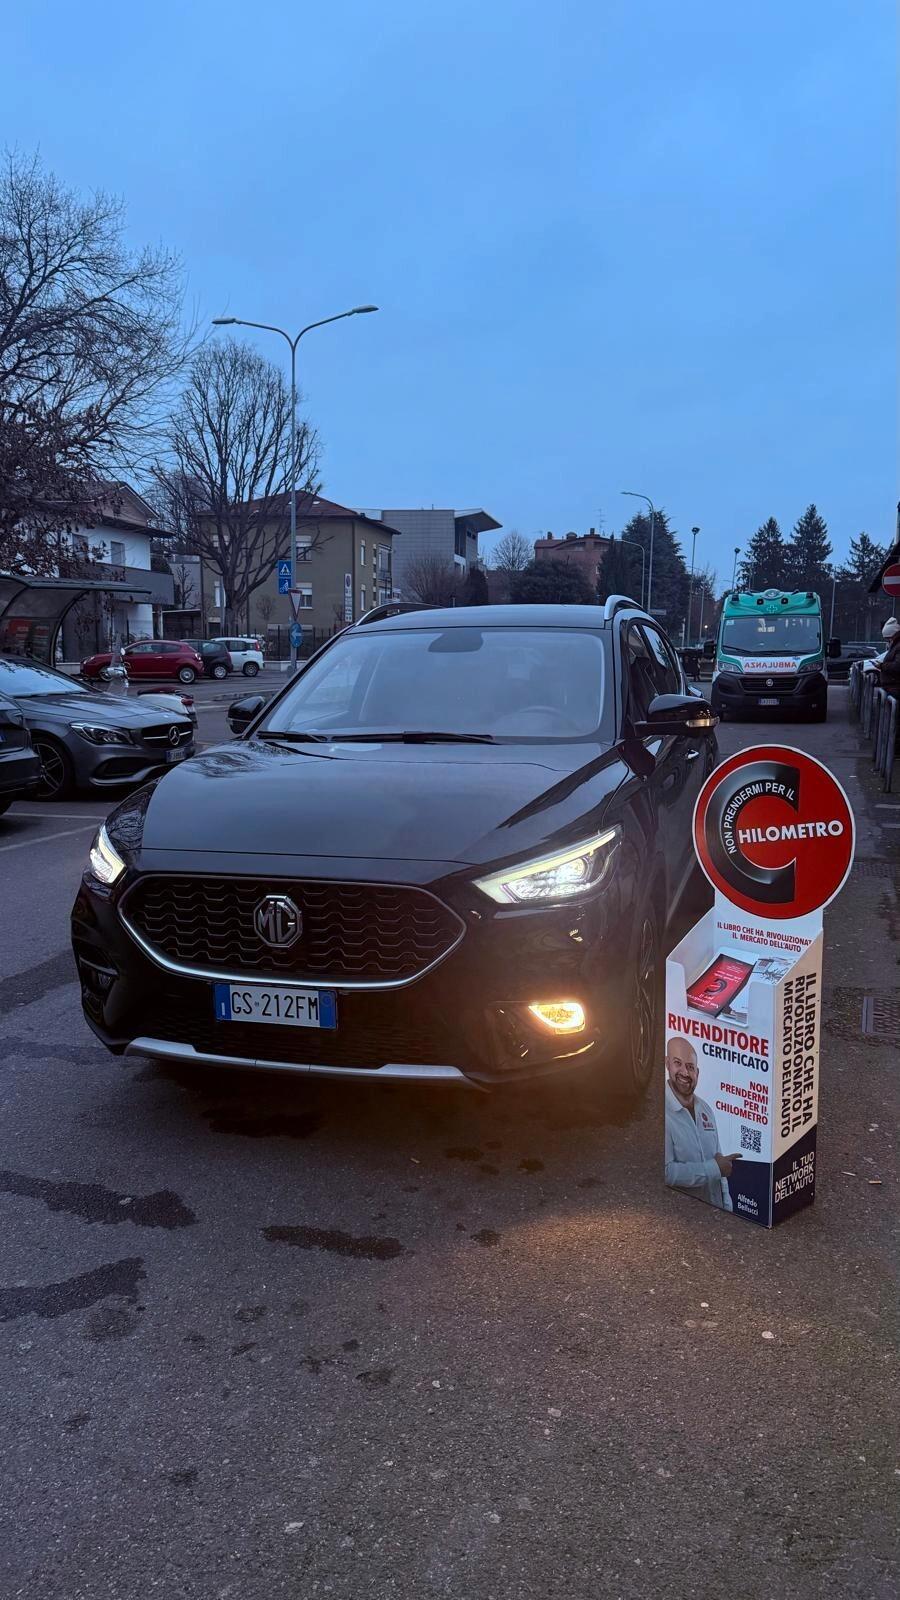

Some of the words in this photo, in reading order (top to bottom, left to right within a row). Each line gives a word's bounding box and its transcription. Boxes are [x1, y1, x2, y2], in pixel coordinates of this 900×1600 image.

[765, 782, 786, 795] PER
[786, 788, 795, 801] IL
[723, 782, 763, 829] PRENDERMI
[724, 831, 737, 854] NON
[738, 820, 844, 844] HILOMETRO
[258, 901, 296, 943] MG
[717, 921, 723, 929] IL
[723, 923, 742, 933] LIBRO
[742, 926, 754, 935] CHE
[755, 929, 764, 937] HA
[766, 931, 812, 947] RIVOLUZIONAT
[740, 933, 768, 946] MERCATO
[769, 940, 802, 953] DELL'AUTO
[806, 972, 817, 991] IL
[782, 980, 794, 1055] MERCATO
[804, 993, 816, 1051] LIBRO
[668, 1013, 769, 1057] RIVENDITORE
[792, 975, 806, 1112] RIVOLUZIONATO
[702, 1042, 769, 1073] CERTIFICATO
[803, 1055, 815, 1093] CHE
[720, 1082, 768, 1105] PRENDERMI
[750, 1081, 768, 1095] NON
[780, 1059, 792, 1138] DELL'AUTO
[715, 1100, 768, 1125] CHILOMETRO
[744, 1100, 759, 1112] PER
[802, 1096, 814, 1126] HA
[791, 1115, 802, 1133] IL
[792, 1160, 799, 1172] IL
[800, 1151, 815, 1167] TUO
[774, 1173, 814, 1204] DELL'AUTO
[775, 1162, 815, 1192] NETWORK
[737, 1193, 758, 1208] Alfredo
[737, 1202, 759, 1216] Bellucci
